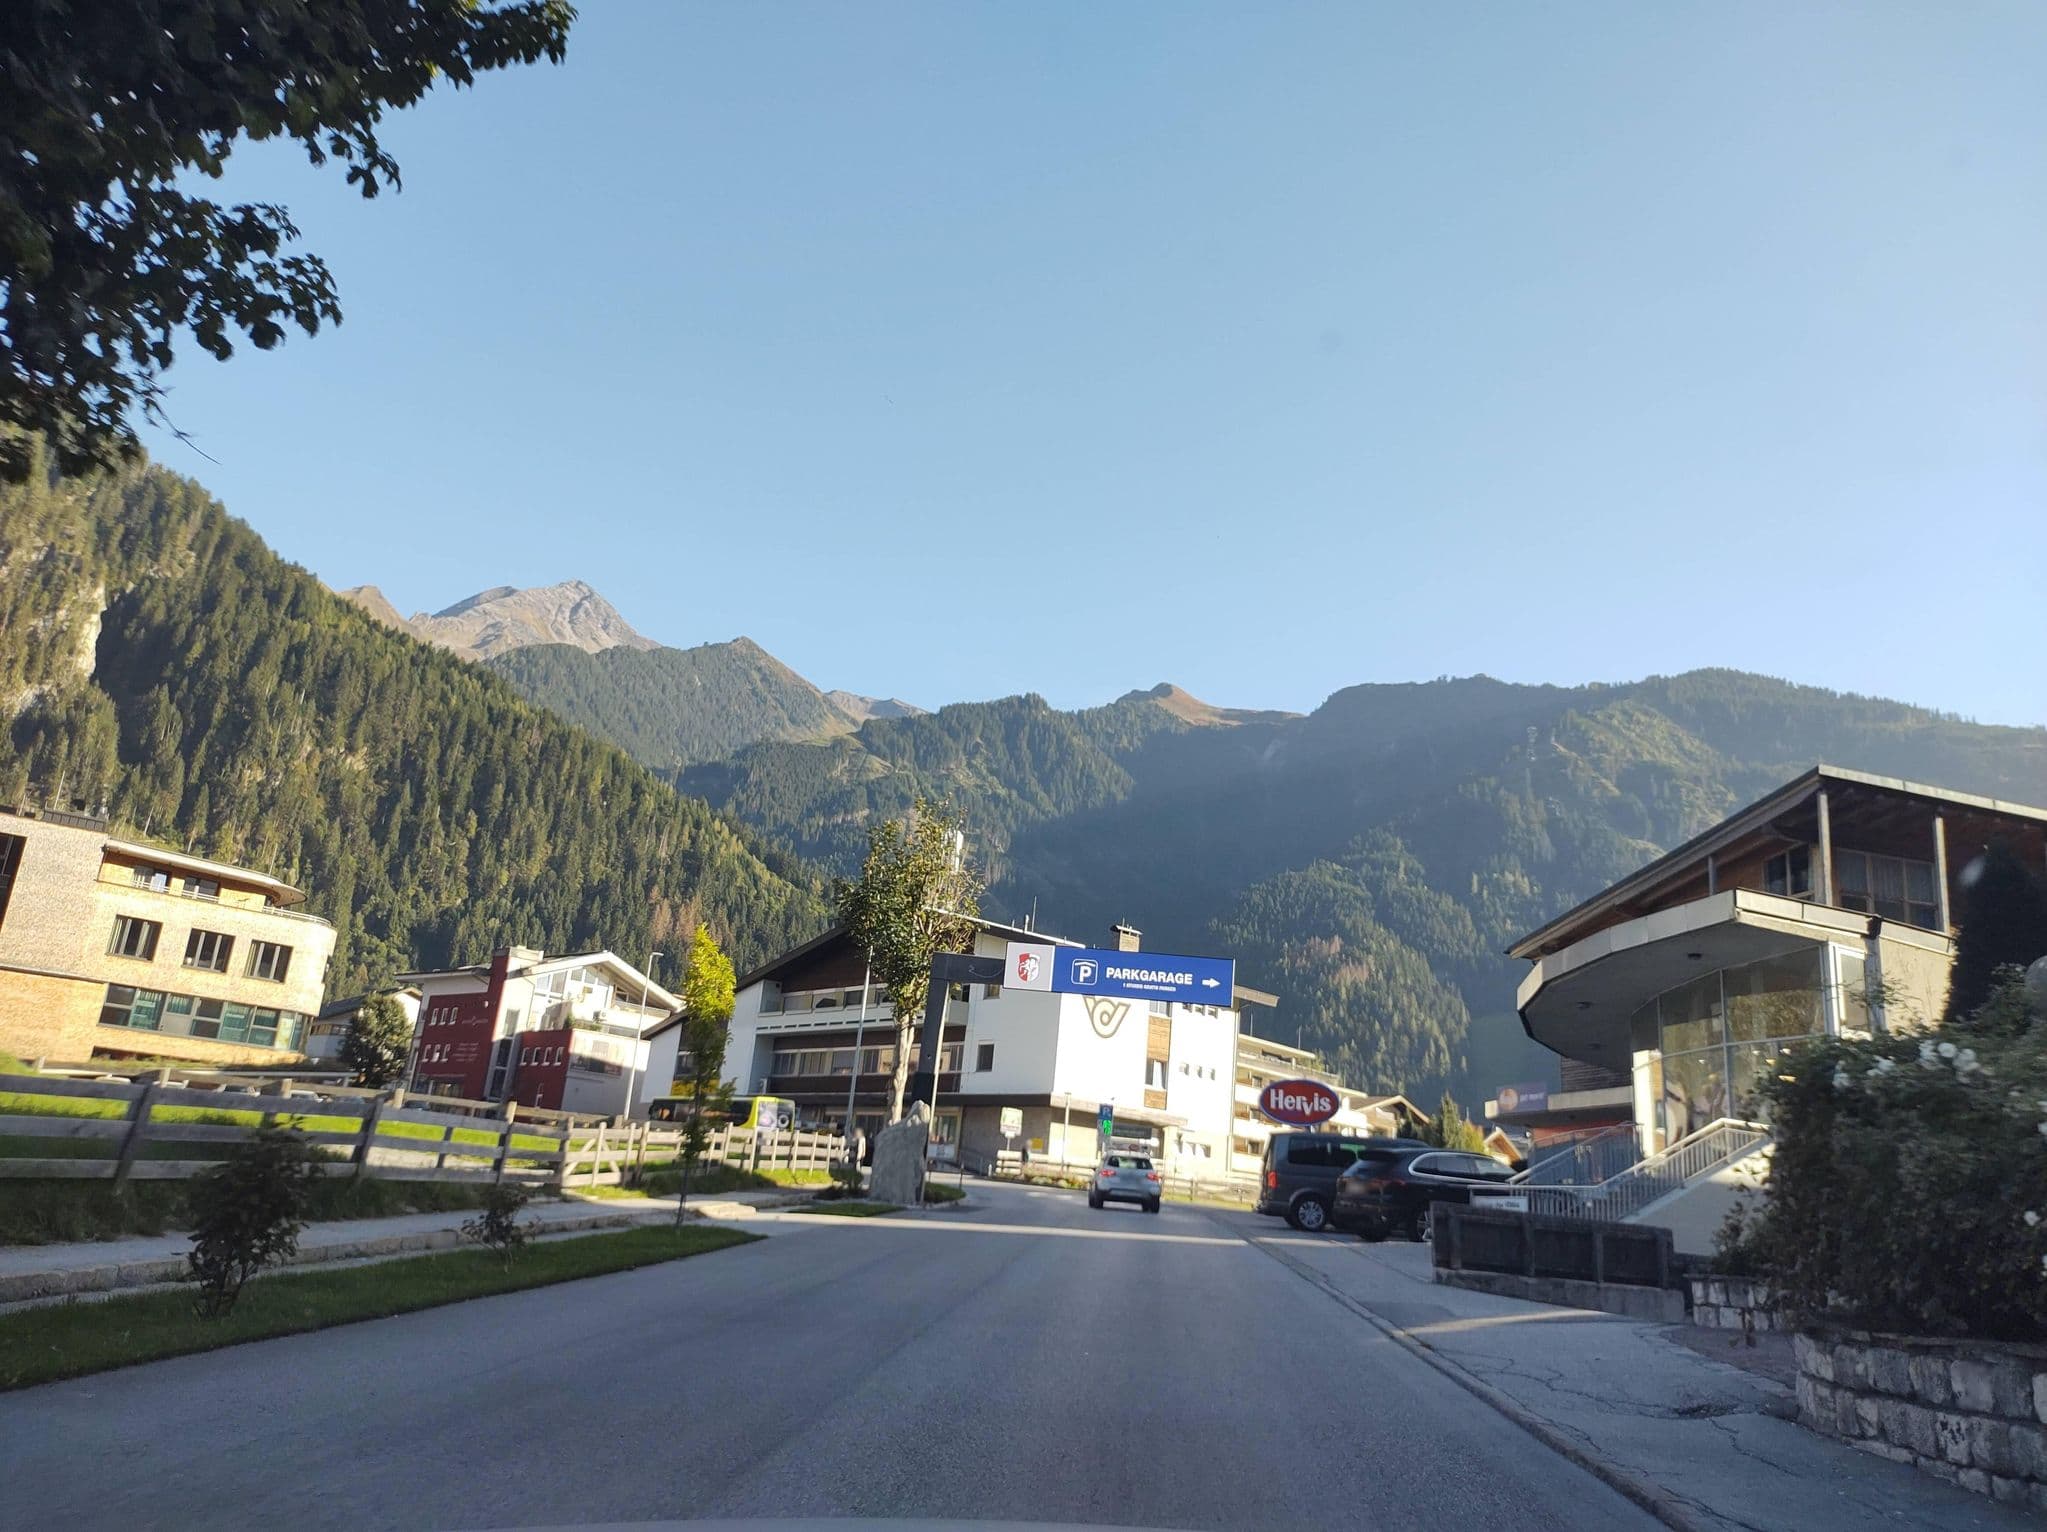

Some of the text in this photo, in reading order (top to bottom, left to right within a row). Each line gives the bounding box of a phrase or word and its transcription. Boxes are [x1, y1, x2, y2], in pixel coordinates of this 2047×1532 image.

[1079, 966, 1092, 982] P
[1106, 967, 1193, 985] PARKGARAGE
[1270, 1088, 1331, 1116] Hervis
